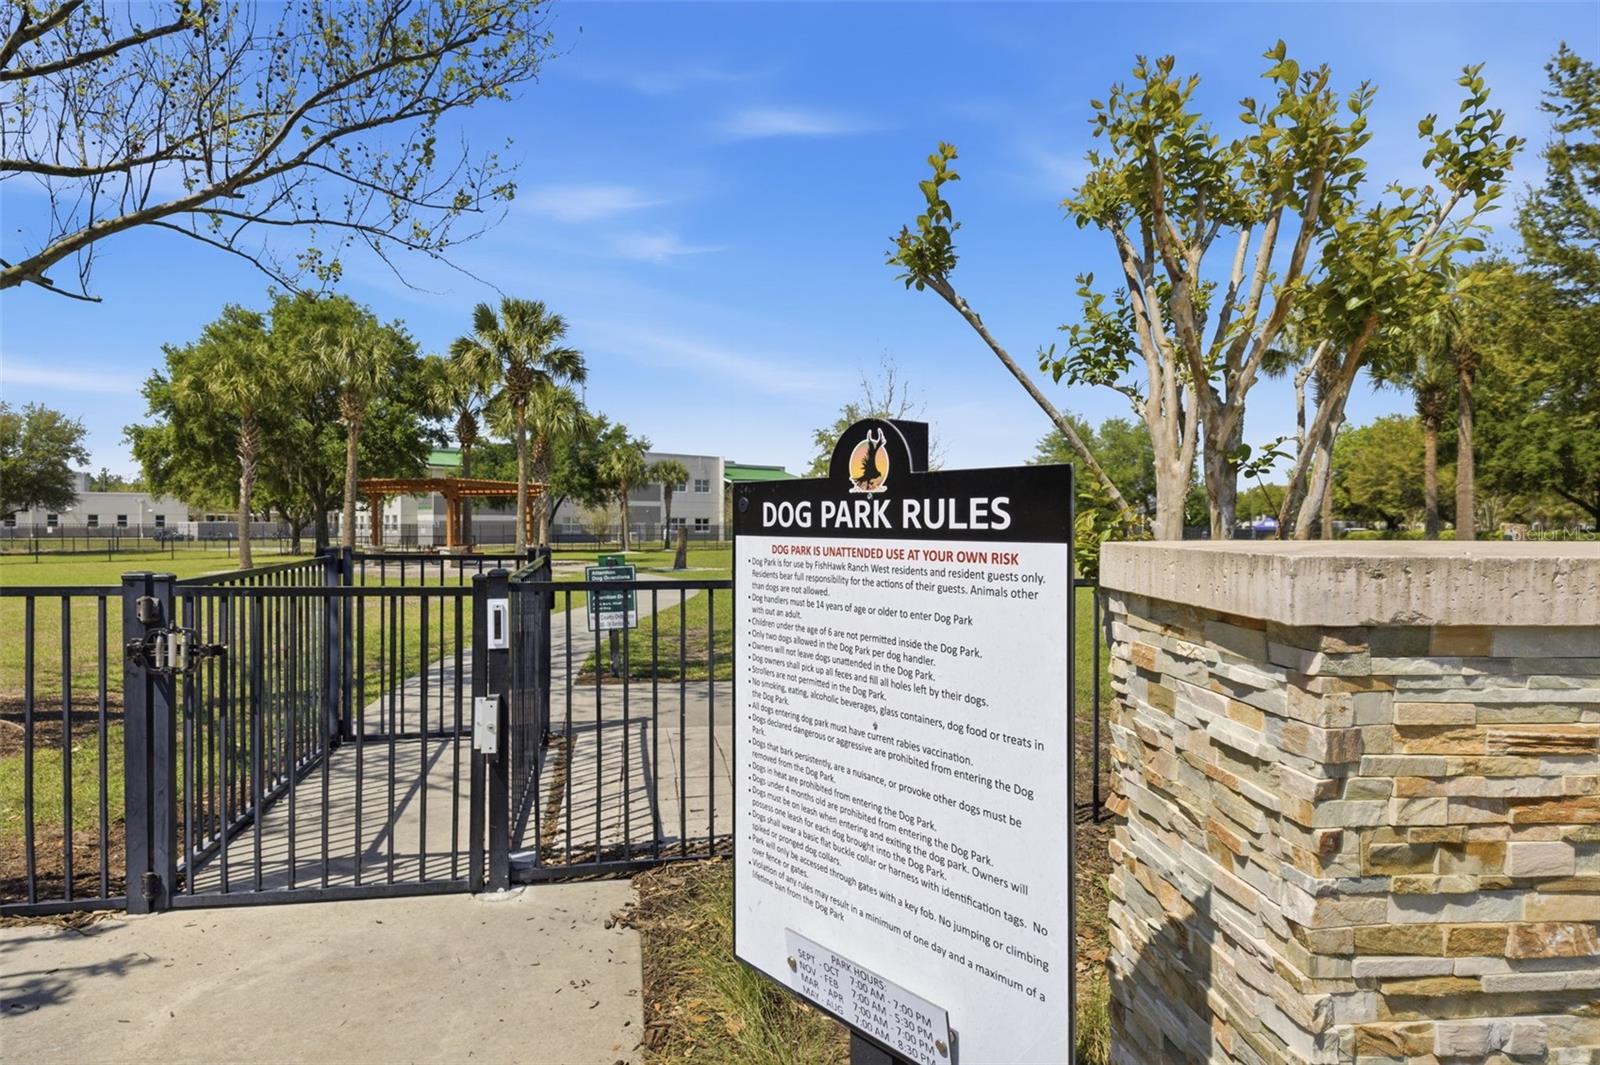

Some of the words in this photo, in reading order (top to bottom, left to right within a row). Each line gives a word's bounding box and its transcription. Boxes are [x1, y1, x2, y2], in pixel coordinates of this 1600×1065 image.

[762, 502, 812, 528] DOG
[820, 499, 892, 528] PARK
[902, 497, 1011, 531] RULES
[751, 557, 763, 567] Dog
[763, 557, 776, 566] Park
[777, 559, 782, 567] is
[783, 558, 792, 567] for
[805, 560, 813, 570] by
[814, 560, 846, 570] FishHawk
[847, 562, 869, 572] Ranch
[870, 564, 890, 574] West
[891, 565, 928, 576] residents
[929, 567, 946, 577] and
[948, 568, 985, 580] resident
[987, 572, 1019, 583] guests
[1021, 572, 1045, 585] only.
[771, 544, 789, 555] DOG
[790, 545, 811, 556] PARK
[813, 546, 821, 556] IS
[822, 546, 883, 559] UNATTENDED
[885, 548, 905, 560] USE
[906, 549, 921, 561] AT
[922, 549, 954, 562] YOUR
[956, 550, 987, 564] OWN
[991, 552, 1019, 566] RISK
[751, 569, 778, 579] Residents
[779, 571, 793, 580] bear
[794, 572, 804, 581] full
[805, 574, 849, 586] responsibility
[850, 575, 860, 585] for
[861, 577, 874, 587] the
[875, 578, 903, 589] actions
[905, 580, 914, 590] of
[915, 581, 935, 591] their
[936, 584, 968, 594] guests.
[969, 585, 1008, 598] Animals
[1010, 587, 1039, 600] other
[877, 606, 898, 617] older
[899, 609, 908, 619] to
[909, 611, 932, 621] enter
[934, 612, 951, 626] Dog
[953, 614, 973, 626] Park
[871, 649, 885, 658] per
[886, 649, 901, 663] dog
[902, 651, 935, 666] handler.
[898, 637, 922, 650] inside
[923, 641, 938, 652] the
[940, 643, 958, 657] Dog
[959, 645, 982, 658] Park.
[869, 674, 878, 684] fill
[879, 677, 889, 687] all
[890, 678, 912, 692] holes
[913, 682, 927, 695] left
[929, 685, 939, 699] by
[941, 688, 962, 701] their
[964, 693, 989, 708] dogs.
[873, 662, 881, 671] in
[882, 663, 895, 674] the
[897, 665, 913, 680] Dog
[914, 668, 935, 681] Park.
[879, 705, 898, 718] glass
[899, 711, 945, 730] containers,
[947, 720, 964, 735] dog
[965, 723, 987, 738] food
[989, 731, 1000, 740] or
[1002, 733, 1032, 748] treats
[1034, 739, 1044, 751] in
[896, 739, 920, 752] rabies
[921, 746, 973, 766] vaccination.
[873, 747, 886, 758] are
[887, 751, 929, 769] prohibited
[930, 760, 952, 775] from
[953, 769, 992, 789] entering
[994, 779, 1011, 792] the
[1013, 783, 1034, 801] Dog
[898, 783, 931, 800] provoke
[932, 793, 957, 807] other
[958, 799, 981, 816] dogs
[982, 809, 1007, 824] must
[1009, 814, 1022, 828] be
[878, 817, 896, 831] from
[898, 826, 933, 847] entering
[933, 838, 948, 851] the
[950, 842, 969, 860] Dog
[970, 850, 994, 867] Park.
[876, 847, 891, 859] into
[892, 852, 906, 865] the
[907, 857, 924, 874] Dog
[926, 864, 947, 881] Park.
[885, 836, 911, 854] exiting
[913, 845, 927, 858] the
[928, 851, 945, 867] dog
[947, 859, 969, 874] park.
[971, 866, 1008, 888] Owners
[1010, 882, 1028, 895] will
[888, 863, 919, 884] harness
[920, 879, 939, 892] with
[941, 885, 1001, 918] identification
[1003, 911, 1027, 928] tags.
[1032, 921, 1048, 936] No
[878, 890, 896, 903] with
[897, 898, 903, 907] a
[904, 899, 918, 915] key
[920, 906, 936, 921] fob.
[938, 914, 951, 928] No
[952, 920, 991, 947] jumping
[992, 940, 1004, 950] or
[1005, 944, 1049, 973] climbing
[831, 955, 851, 972] PARK
[854, 967, 887, 992] HOURS:
[902, 930, 912, 940] of
[912, 935, 929, 948] one
[930, 941, 947, 958] day
[948, 951, 965, 965] and
[967, 960, 973, 968] a
[975, 963, 1023, 992] maximum
[1025, 987, 1037, 998] of
[1039, 992, 1045, 1002] a
[798, 948, 815, 964] SEPT
[824, 963, 839, 977] OCT
[850, 976, 868, 993] 7:00
[870, 988, 885, 1002] AM
[894, 1000, 913, 1018] 7:00
[916, 1012, 932, 1028] PM
[799, 961, 816, 976] NOV
[824, 975, 838, 989] FEB
[852, 989, 869, 1006] 7:00
[872, 1001, 886, 1015] AM
[895, 1014, 914, 1031] 5:30
[917, 1026, 933, 1042] PM
[801, 973, 818, 988] MAR
[828, 989, 844, 1003] APR
[853, 1002, 871, 1019] 7:00
[874, 1014, 888, 1028] AM
[897, 1026, 916, 1044] 7:00
[919, 1040, 935, 1055] PM
[855, 1015, 872, 1032] 7:00
[875, 1028, 889, 1041] AM
[898, 1040, 918, 1058] 8:30
[921, 1053, 936, 1065] PM
